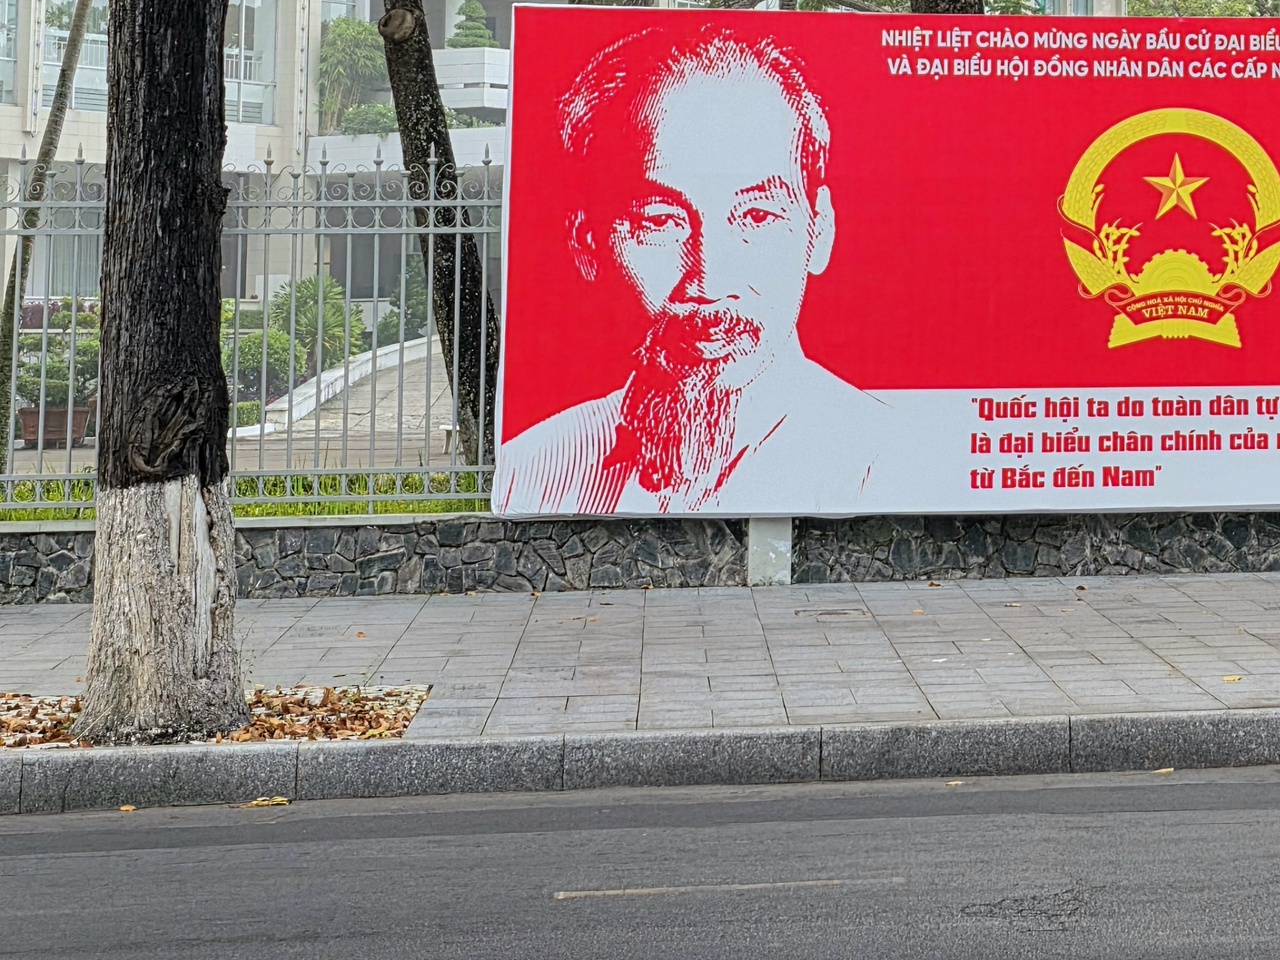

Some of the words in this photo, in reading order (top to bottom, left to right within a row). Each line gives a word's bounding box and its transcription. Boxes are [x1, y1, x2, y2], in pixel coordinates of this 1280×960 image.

[882, 26, 933, 51] NHIỆT
[937, 27, 972, 52] LIỆT
[976, 28, 1029, 48] CHÀO
[1034, 28, 1087, 49] MỪNG
[1093, 29, 1141, 49] NGÀY
[1146, 28, 1180, 49] BẦU
[1185, 29, 1211, 50] CỬ
[1214, 35, 1244, 55] ĐẠI
[887, 54, 912, 75] VÀ
[916, 58, 948, 80] ĐẠI
[954, 51, 991, 76] BIỂU
[997, 56, 1028, 81] HỘI
[1034, 54, 1088, 77] ĐỒNG
[1094, 57, 1142, 77] NHÂN
[1147, 57, 1184, 77] DÂN
[1189, 58, 1226, 78] CÁC
[1231, 57, 1267, 78] CẤP
[1142, 304, 1174, 318] VIỆT
[1178, 305, 1209, 318] NAM
[1045, 397, 1079, 422] hội
[1087, 398, 1109, 417] ta
[1117, 397, 1144, 417] do
[1152, 396, 1201, 416] toàn
[1210, 395, 1248, 415] dân
[1256, 396, 1279, 420] tự
[971, 433, 991, 453] là
[999, 433, 1033, 458] đại
[1042, 427, 1090, 452] biểu
[1099, 431, 1152, 452] chân
[1161, 430, 1221, 451] chính
[1230, 427, 1268, 450] của
[970, 468, 995, 489] từ
[1002, 465, 1044, 488] Bắc
[1053, 464, 1094, 487] đến
